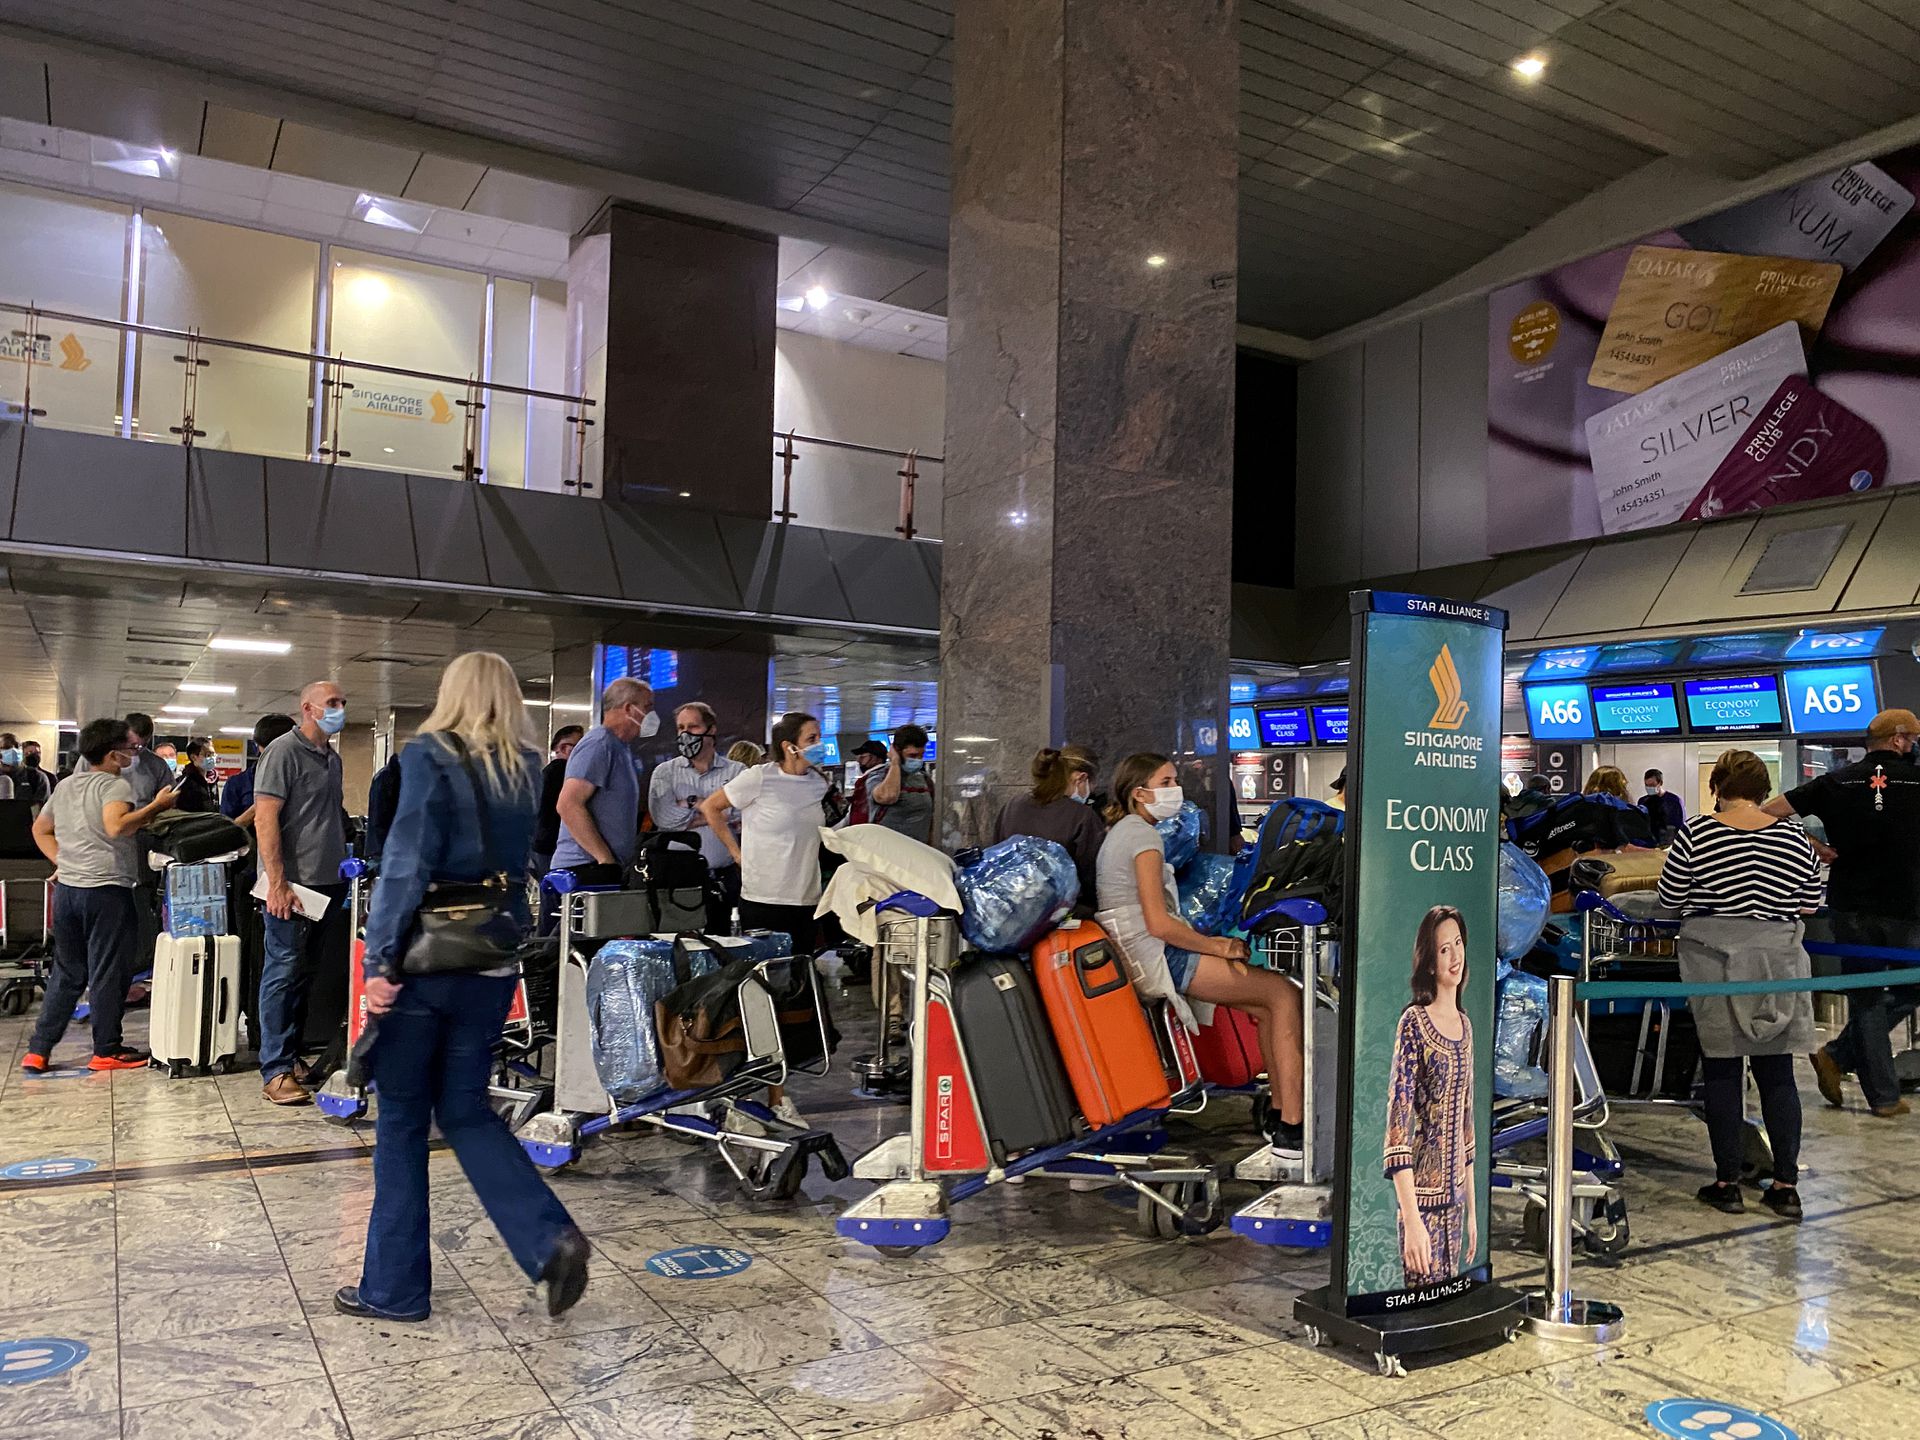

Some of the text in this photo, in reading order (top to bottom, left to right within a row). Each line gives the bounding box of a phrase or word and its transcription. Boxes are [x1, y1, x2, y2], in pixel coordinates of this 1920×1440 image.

[1831, 178, 1862, 206] CLUB
[1840, 167, 1896, 214] PRIVILEGE
[1636, 334, 1663, 346] Smith
[352, 389, 423, 408] SINGAPORE
[366, 401, 423, 416] AIRLINES
[1640, 395, 1753, 464] SILVER
[1743, 390, 1799, 458] PRIVILEGE
[1754, 428, 1784, 463] CLUB
[1612, 471, 1661, 499] John Smith
[1615, 488, 1666, 516] 145434351
[1407, 599, 1483, 620] STAR ALLIANCE
[1540, 699, 1582, 725] A66
[1611, 704, 1660, 716] ECONOMY
[1705, 698, 1760, 711] ECONOMY
[1803, 683, 1862, 714] A65
[1621, 714, 1653, 724] CLASS
[1717, 708, 1751, 719] CLASS
[1404, 730, 1483, 751] SINGAPORE
[1413, 750, 1478, 770] AIRLINES
[1385, 798, 1489, 832] ECONOMY
[1409, 839, 1474, 872] CLASS
[939, 1095, 951, 1143] SPAR
[1385, 1280, 1464, 1308] STAR ALLIANCE
